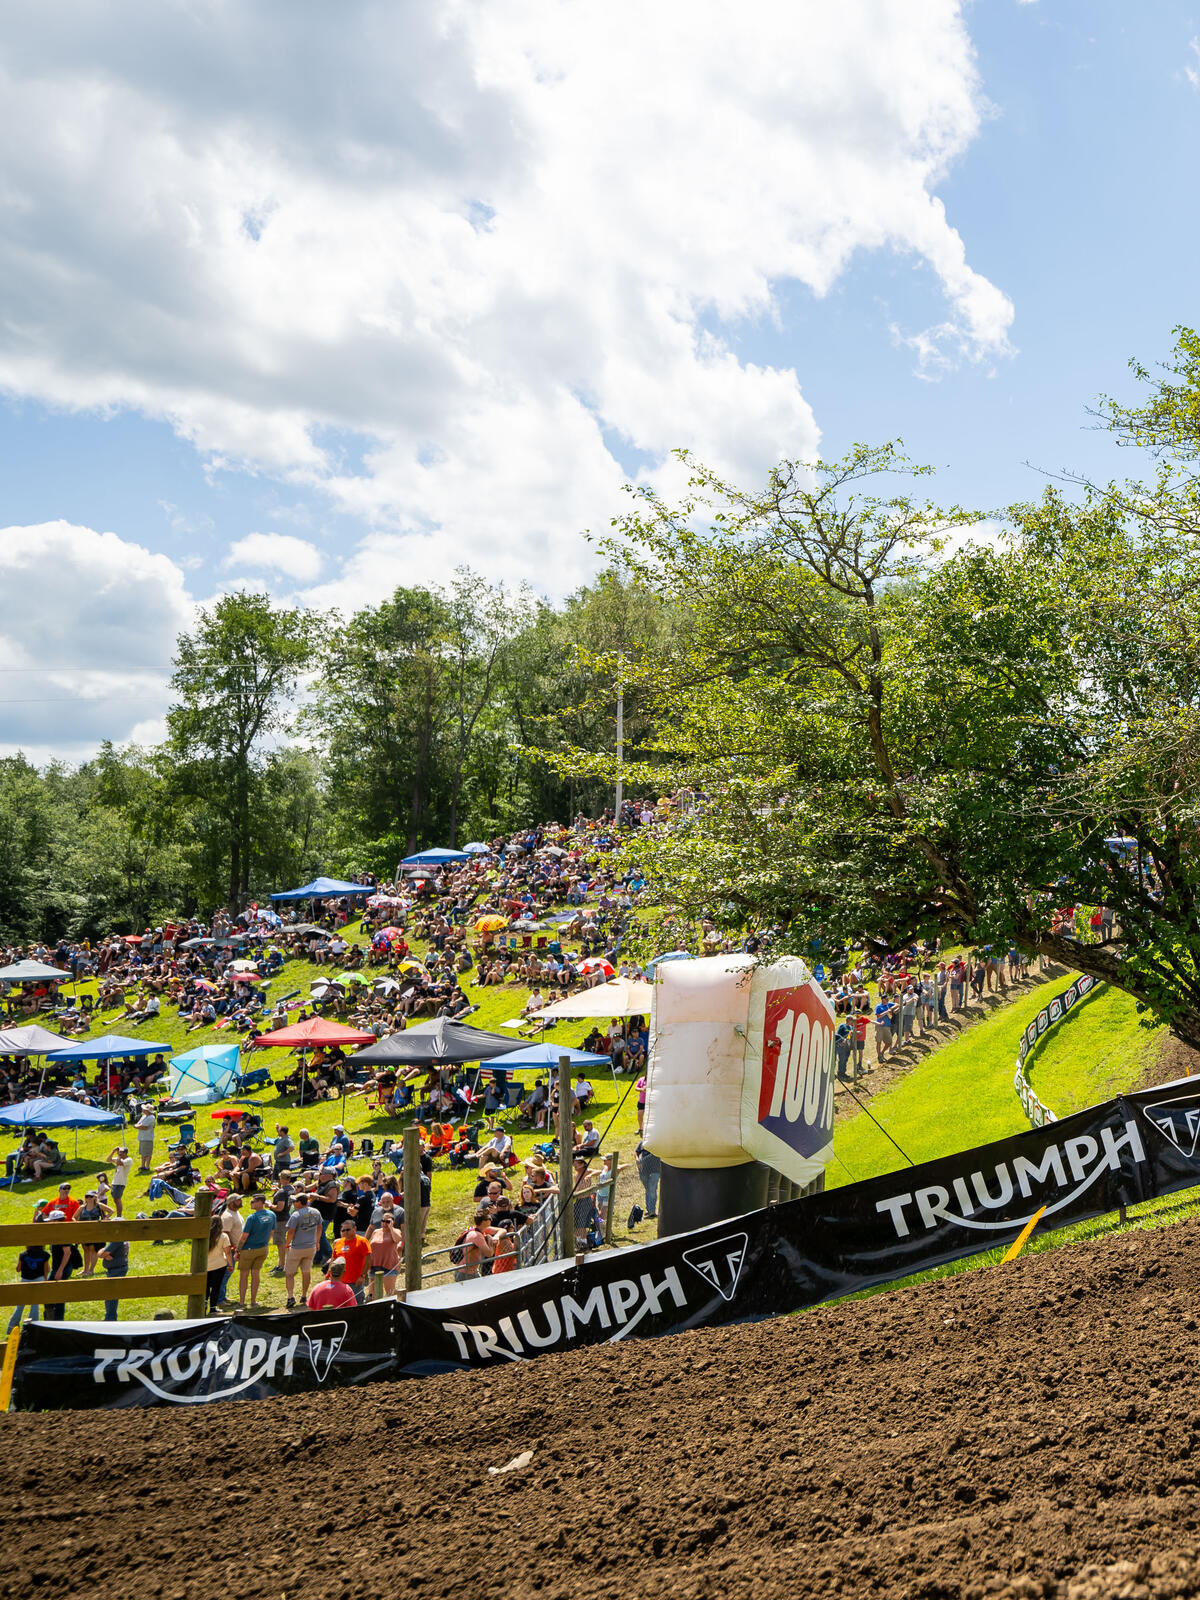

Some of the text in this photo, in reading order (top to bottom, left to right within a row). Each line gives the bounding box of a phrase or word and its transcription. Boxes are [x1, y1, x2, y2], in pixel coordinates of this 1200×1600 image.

[768, 1008, 834, 1131] 100%
[876, 1120, 1146, 1238] TRIUMPH
[442, 1266, 687, 1362] TRIUMPH
[94, 1334, 300, 1402] TRIUMPH
